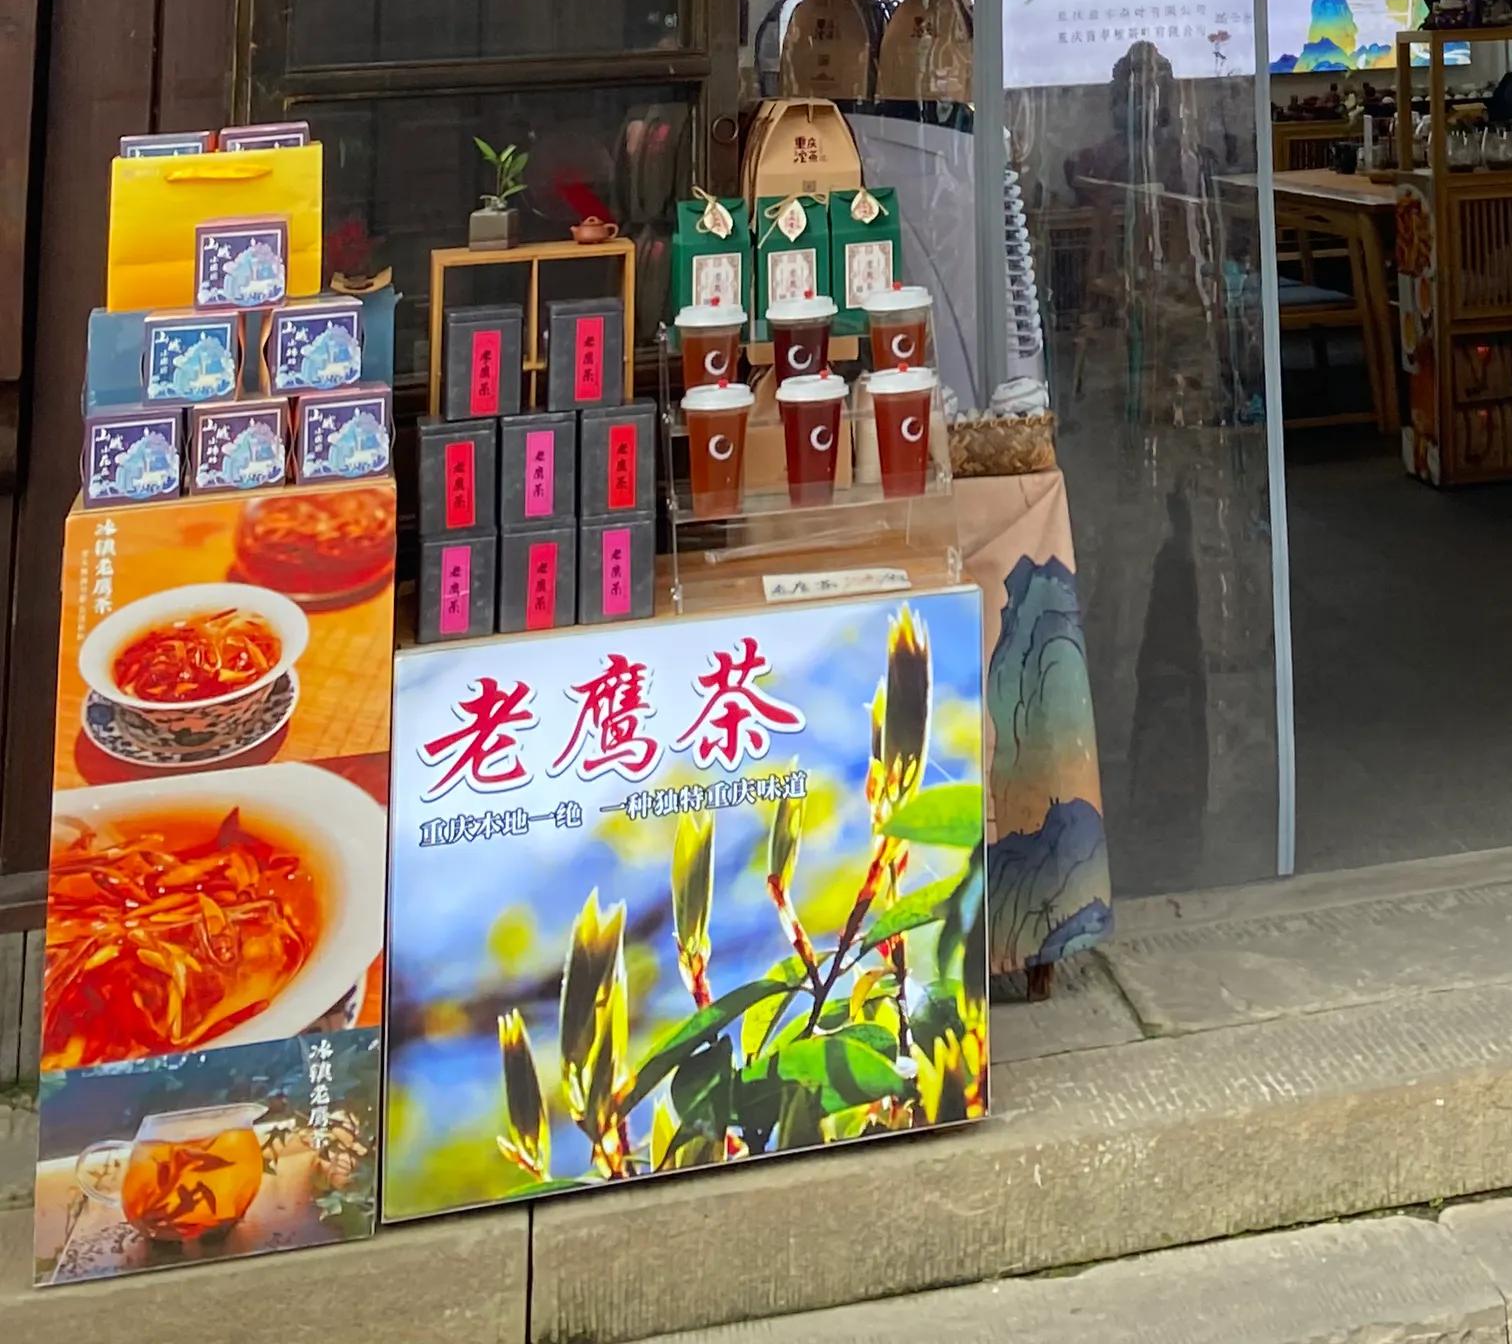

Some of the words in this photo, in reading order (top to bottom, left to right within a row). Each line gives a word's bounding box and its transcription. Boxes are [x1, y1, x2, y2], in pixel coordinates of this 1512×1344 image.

[421, 636, 804, 798] 老鹰茶
[418, 799, 583, 848] 重庆本地一绝
[600, 769, 808, 822] 一种独特重庆味道
